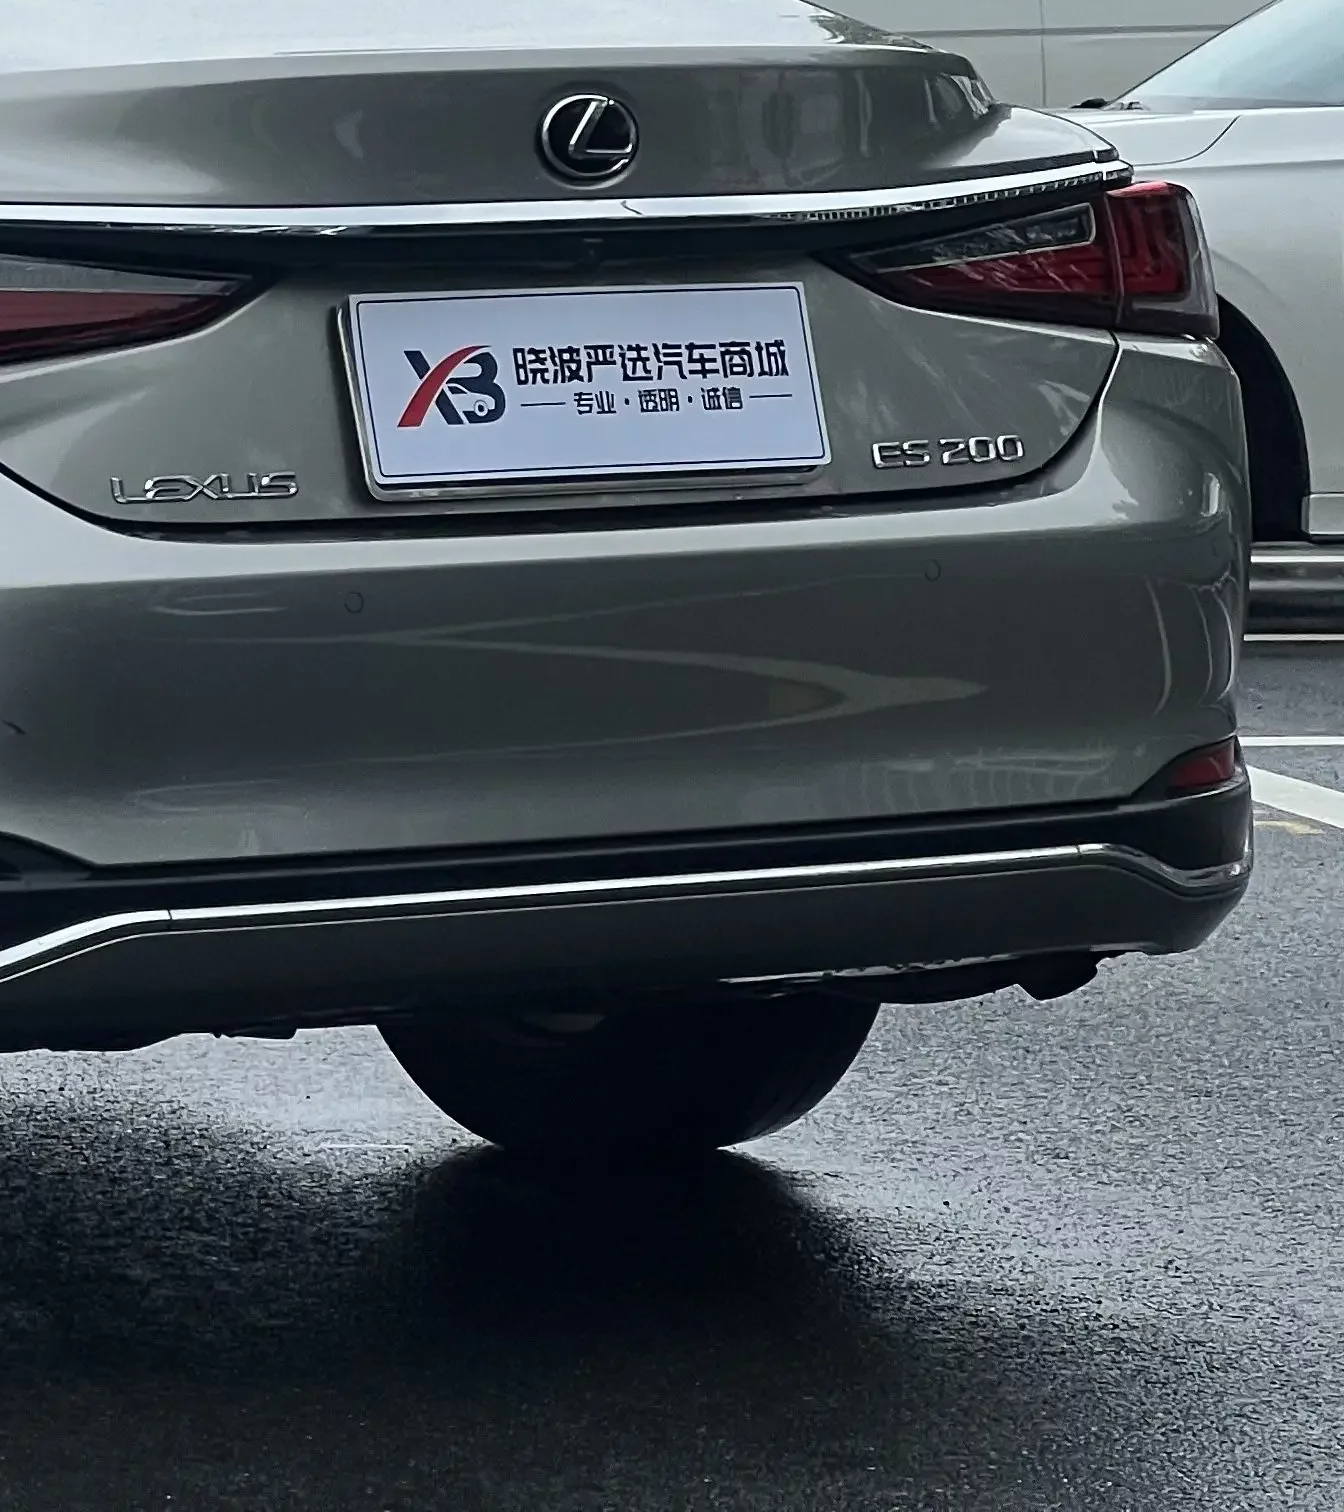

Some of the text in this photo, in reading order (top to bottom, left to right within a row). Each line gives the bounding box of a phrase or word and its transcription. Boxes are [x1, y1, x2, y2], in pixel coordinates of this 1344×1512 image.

[512, 339, 790, 386] 晓波严选汽车商城
[872, 434, 1025, 469] ES 200
[109, 471, 299, 504] LEXUS
